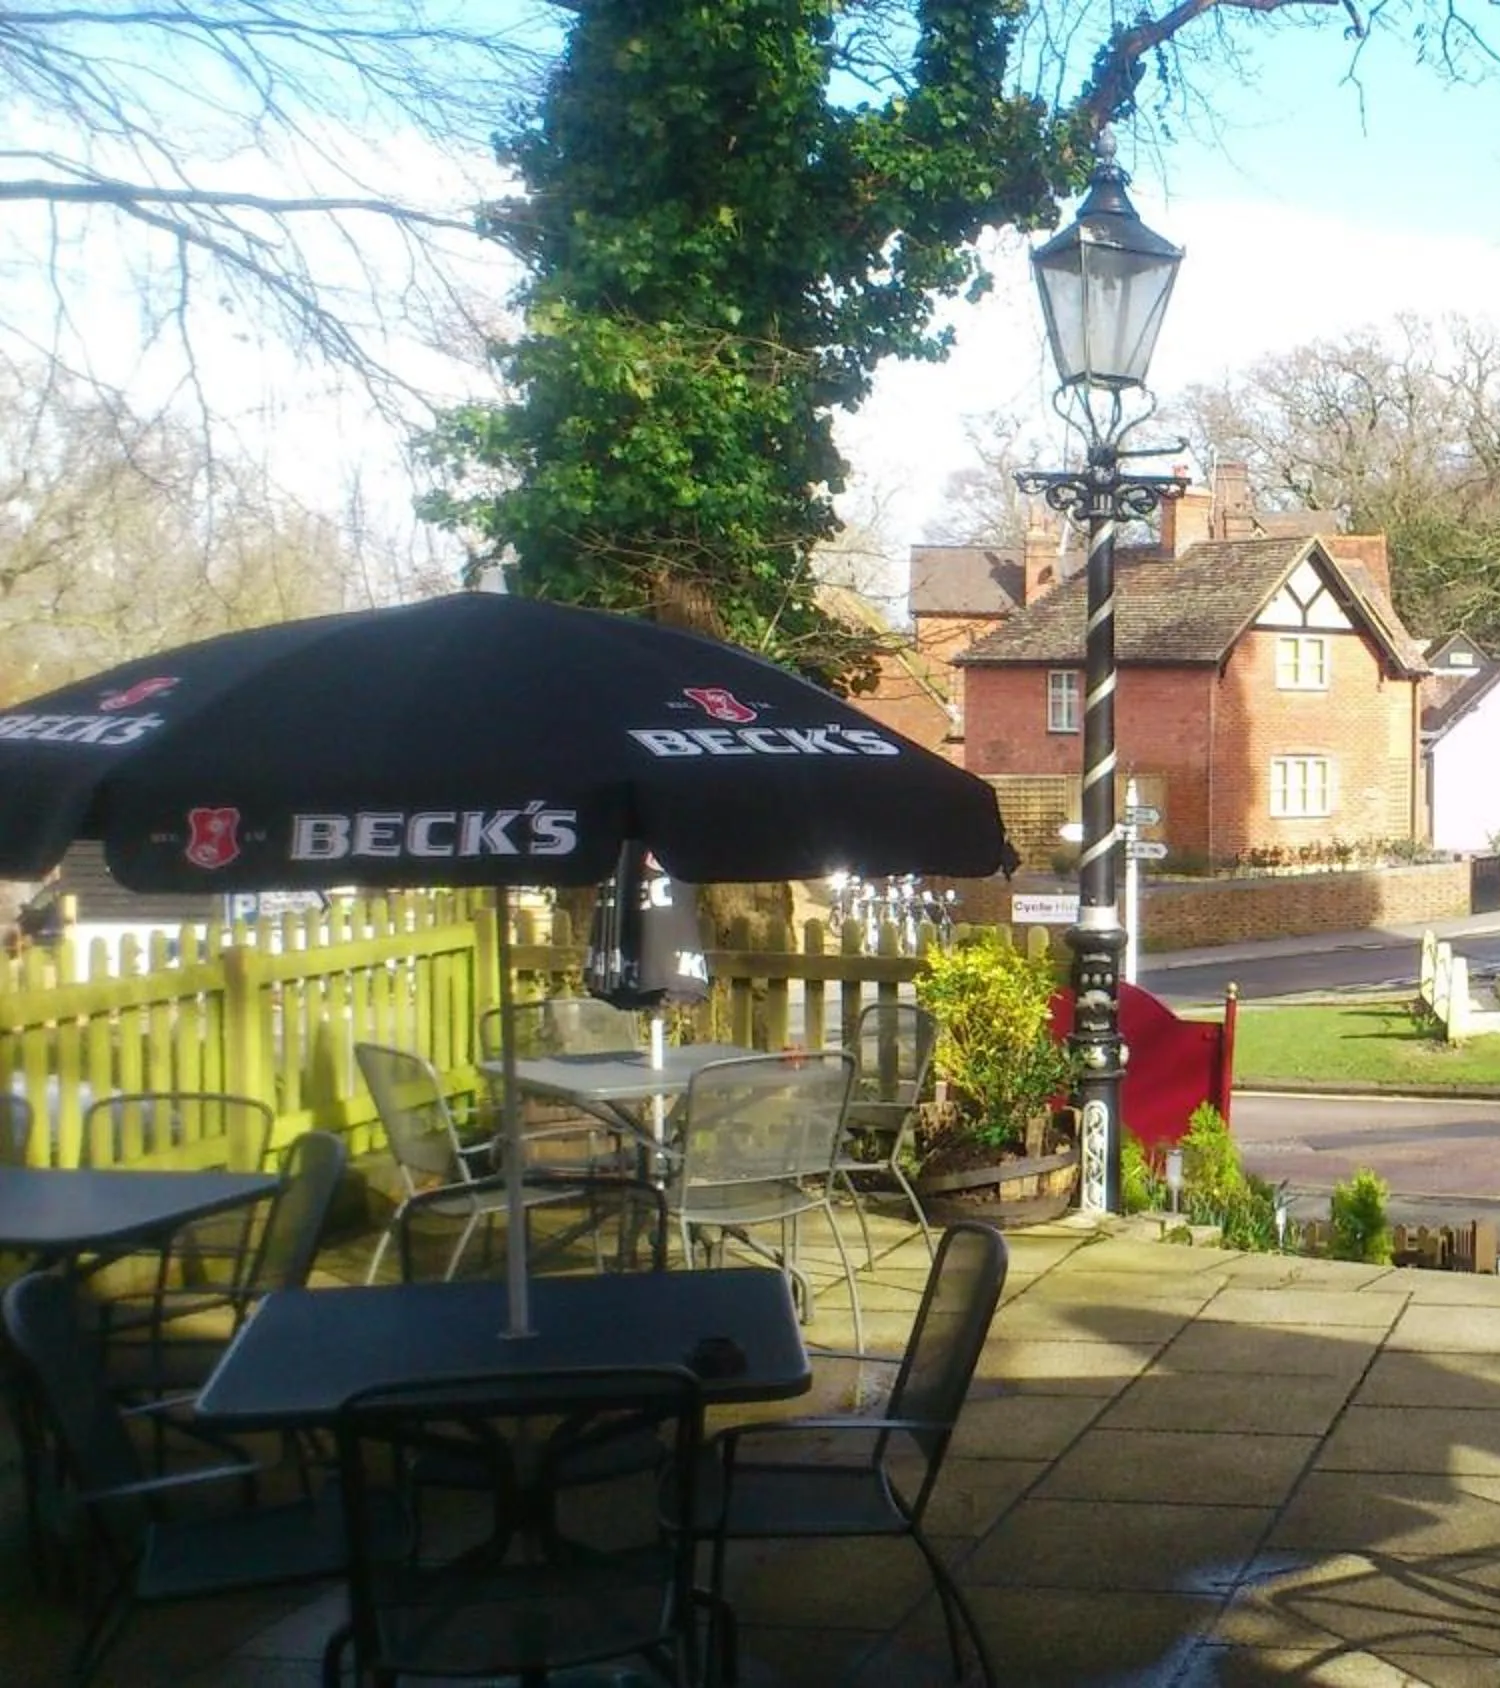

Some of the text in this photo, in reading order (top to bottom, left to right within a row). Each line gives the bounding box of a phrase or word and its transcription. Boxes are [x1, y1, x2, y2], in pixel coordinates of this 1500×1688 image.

[628, 723, 900, 757] BECK'S
[290, 801, 577, 860] BECK'S
[1014, 901, 1053, 913] Cycle
